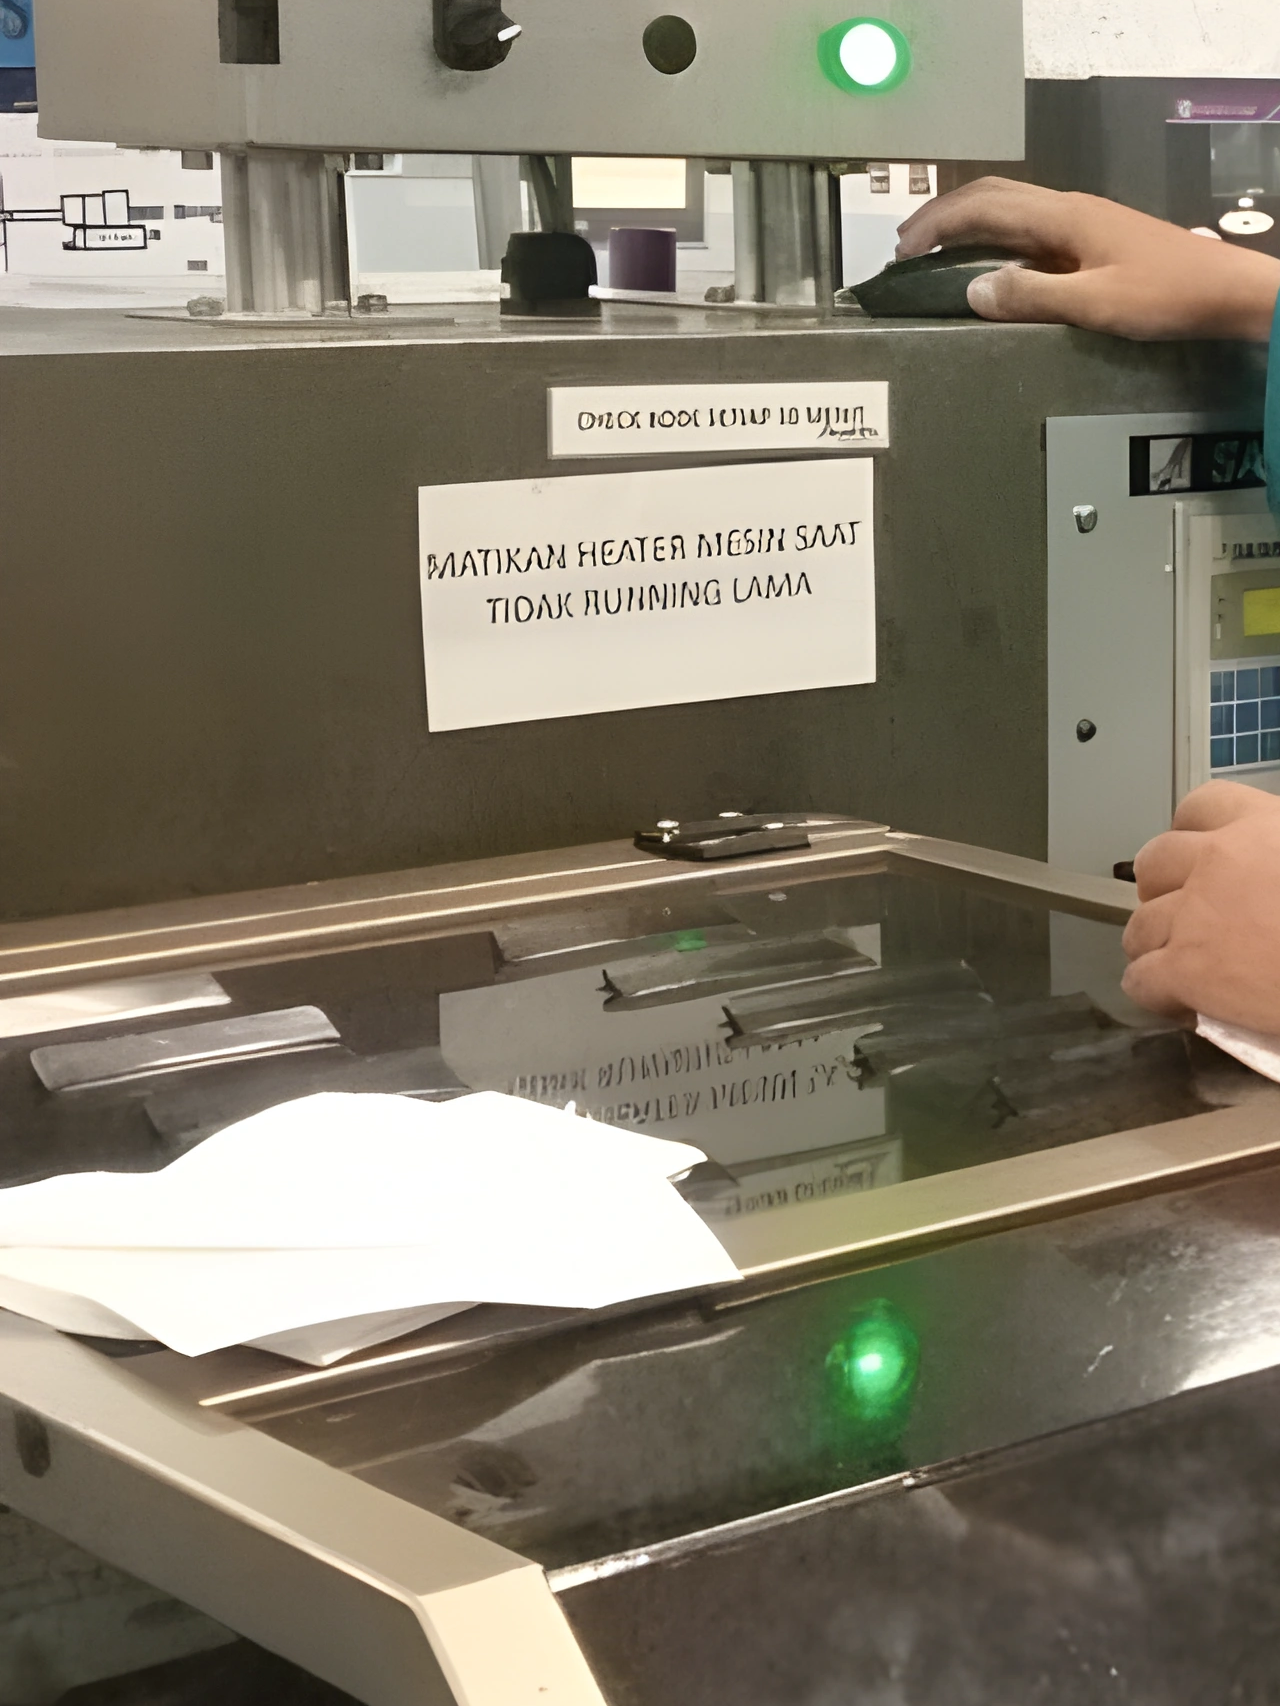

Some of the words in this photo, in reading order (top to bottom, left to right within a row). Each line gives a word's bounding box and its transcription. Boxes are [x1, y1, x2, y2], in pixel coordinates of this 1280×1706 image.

[427, 544, 566, 579] MATIKAN
[578, 535, 685, 567] HEATER
[698, 528, 785, 558] MESIN
[796, 521, 862, 551] SAAT
[486, 593, 573, 623] TIDAK
[585, 579, 721, 616] RUNNING
[734, 572, 812, 603] LAMA
